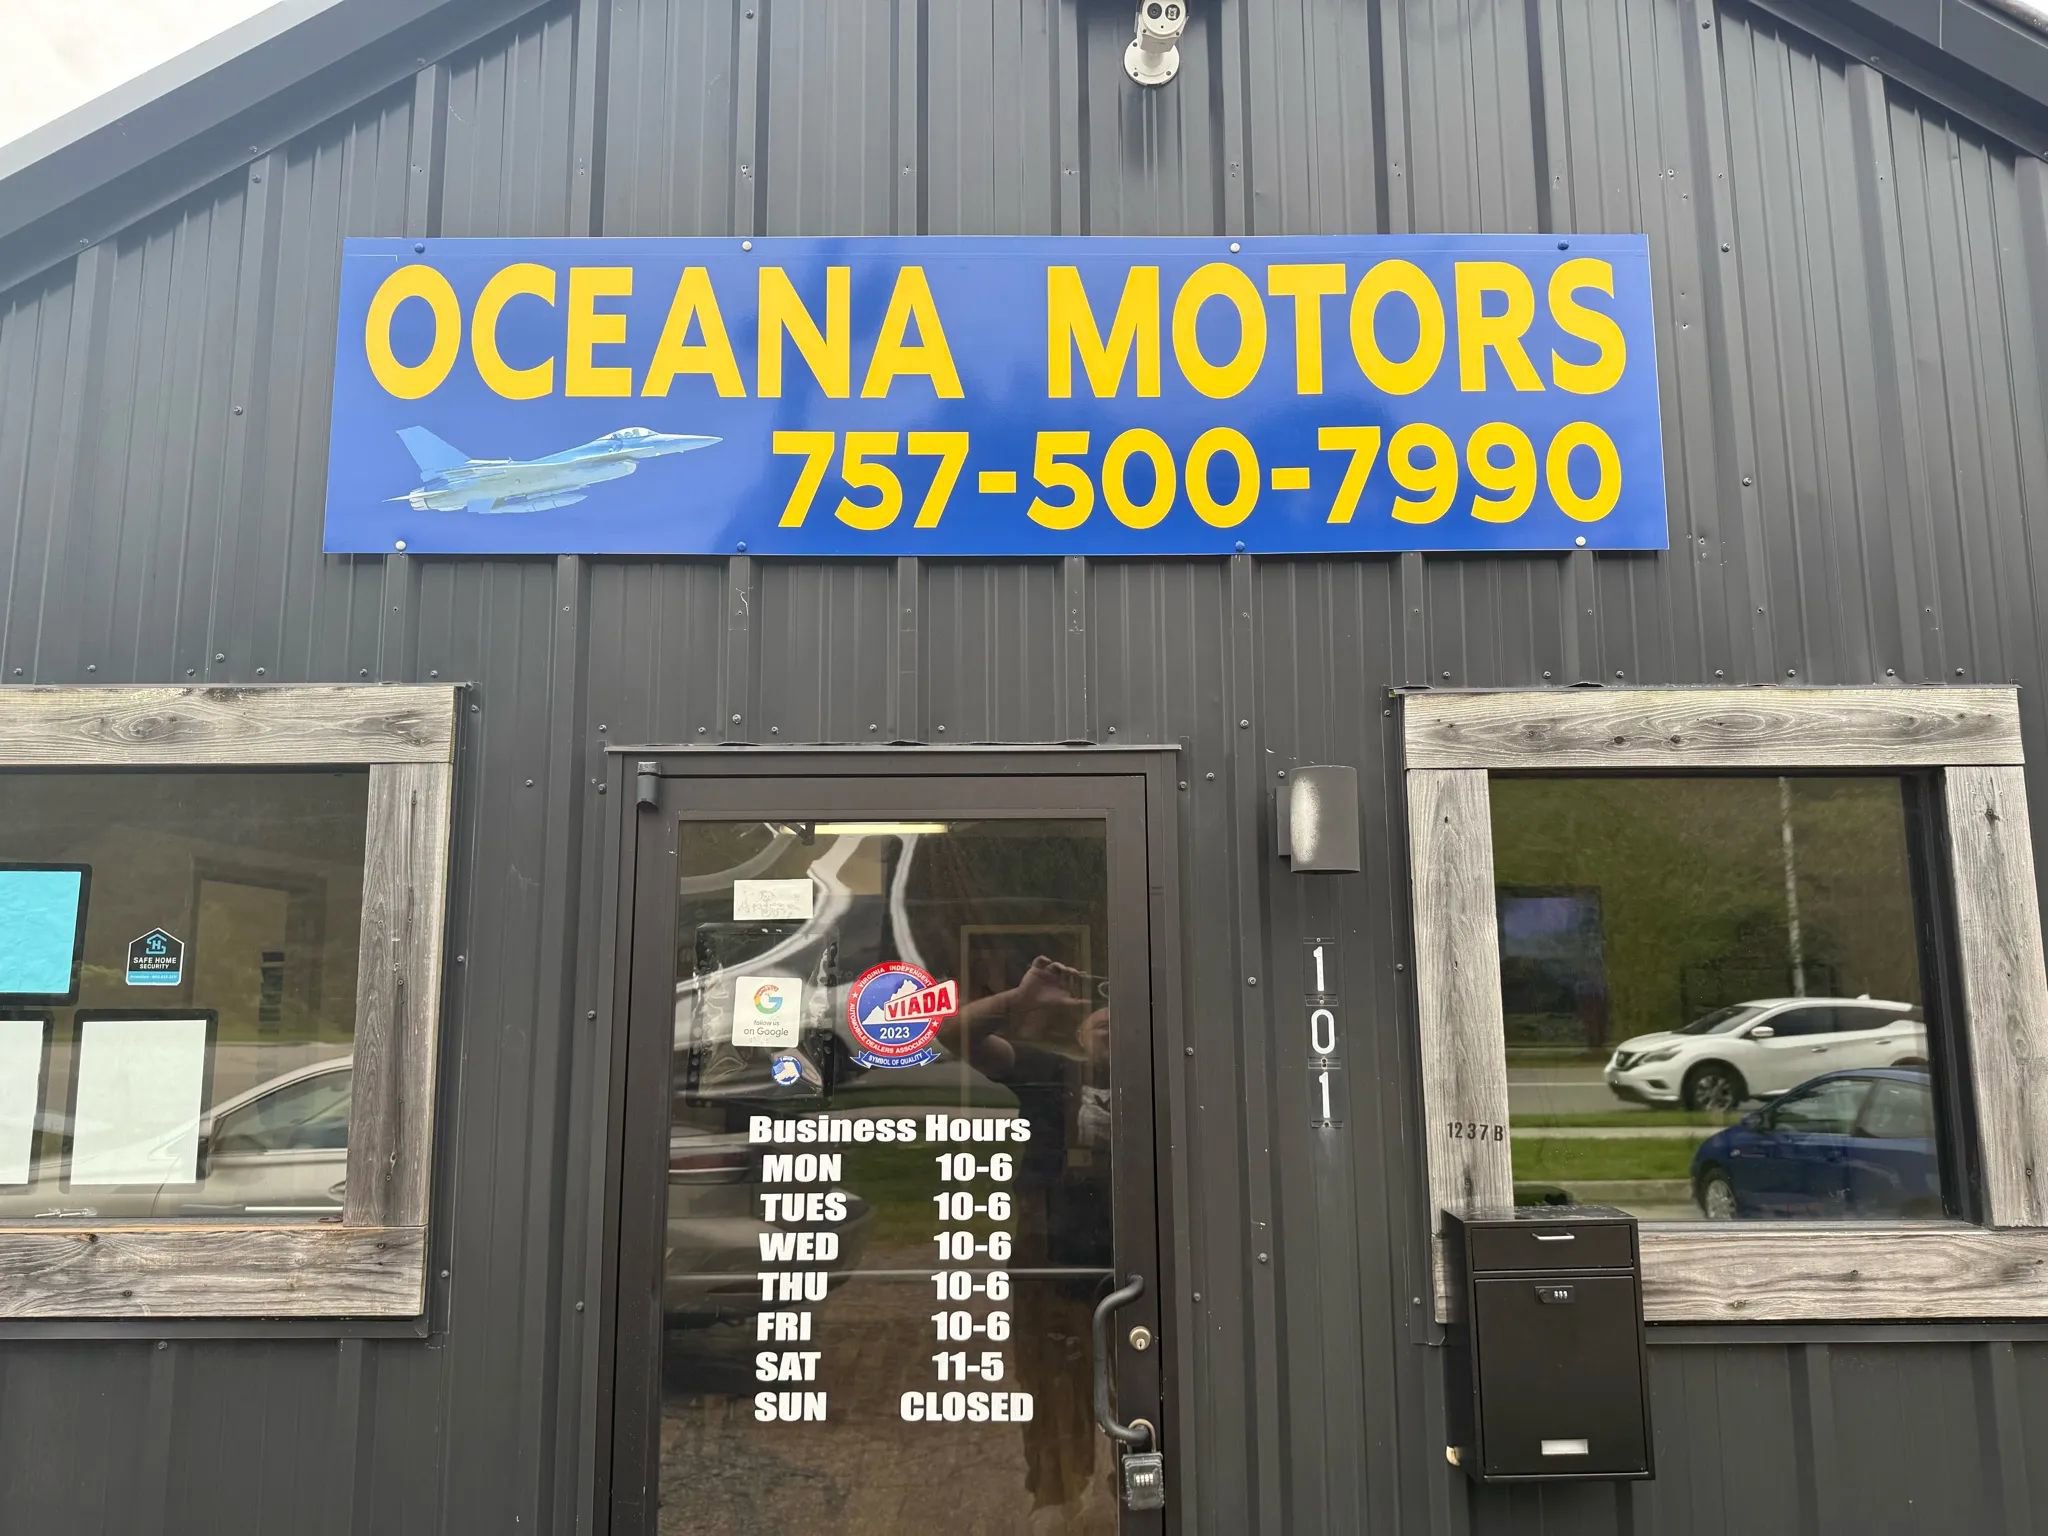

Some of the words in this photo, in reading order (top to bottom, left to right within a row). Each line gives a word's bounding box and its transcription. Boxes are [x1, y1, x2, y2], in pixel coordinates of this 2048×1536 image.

[365, 263, 965, 400] OCEANA
[1047, 257, 1627, 399] MOTORS
[772, 421, 1622, 531] 757-500-7990
[858, 967, 886, 988] VIRGINIA
[889, 965, 933, 987] INDEPENDENT
[888, 986, 952, 1018] VIADA
[743, 1028, 755, 1036] on
[756, 1027, 789, 1037] Google
[849, 1003, 867, 1040] AUTOMOBILE
[865, 1038, 895, 1054] DEALERS
[895, 1030, 934, 1054] ASSOCIATION
[880, 1027, 910, 1039] 2023
[868, 1054, 891, 1066] SYMBOL
[891, 1058, 899, 1066] OF
[899, 1053, 923, 1065] QUALITY
[749, 1115, 917, 1143] Business
[925, 1114, 1031, 1142] Hours
[762, 1153, 842, 1182] MON
[935, 1153, 1013, 1181] 10-6
[760, 1193, 847, 1222] TUES
[933, 1192, 1011, 1221] 10-6
[758, 1232, 839, 1261] WED
[933, 1231, 1012, 1260] 10-6
[757, 1271, 828, 1301] THU
[931, 1271, 1010, 1300] 10-6
[756, 1312, 812, 1341] FRI
[931, 1311, 1010, 1341] 10-6
[755, 1352, 821, 1381] SAT
[932, 1351, 1005, 1381] 11-5
[754, 1392, 827, 1421] SUN
[900, 1391, 1034, 1421] CLOSED
